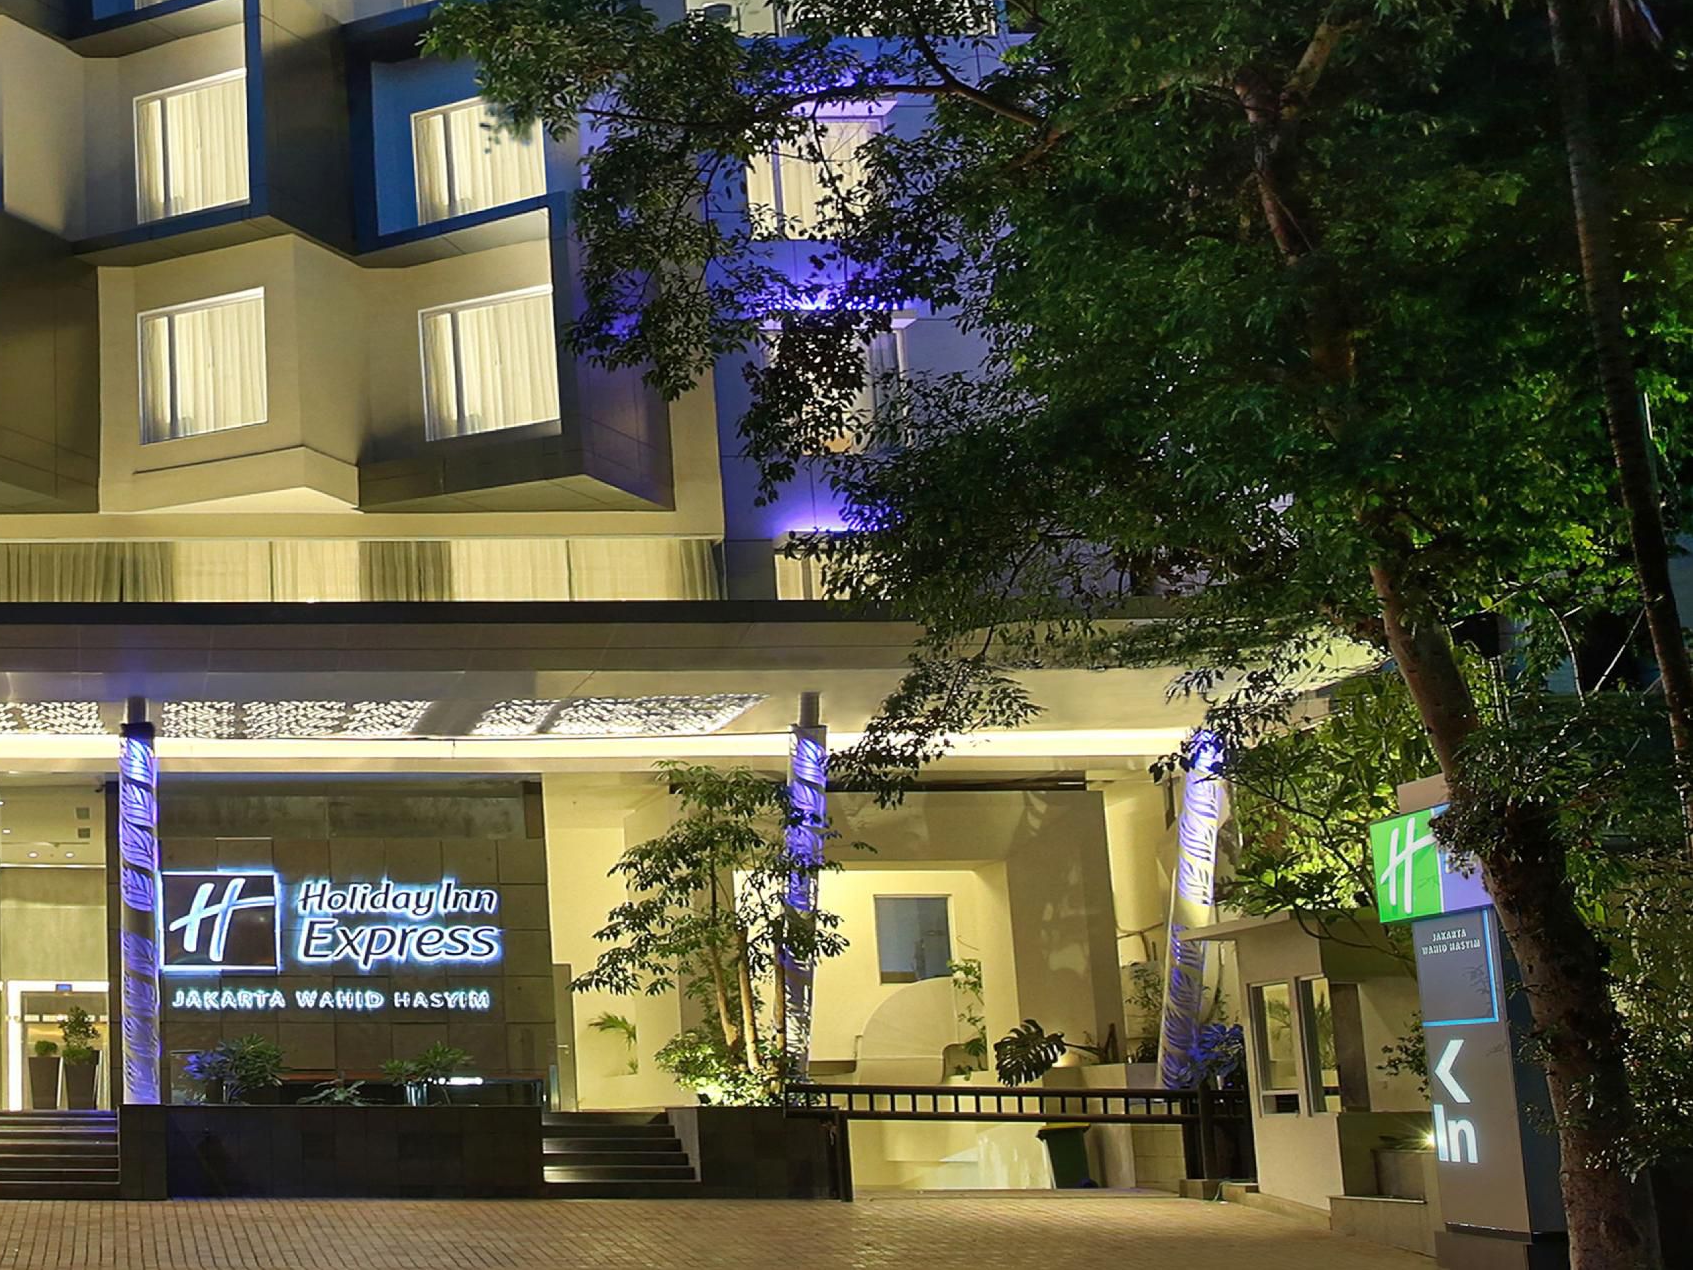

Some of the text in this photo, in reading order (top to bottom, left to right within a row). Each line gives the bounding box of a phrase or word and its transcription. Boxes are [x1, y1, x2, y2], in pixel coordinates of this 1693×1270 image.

[298, 881, 497, 918] Holiday Inn
[302, 919, 496, 968] Express
[1421, 938, 1481, 955] WAHID HASYIM
[1431, 928, 1467, 942] JAKARTA
[172, 990, 491, 1009] JAKARTA WAHID HASYIM
[1433, 1103, 1479, 1164] In
